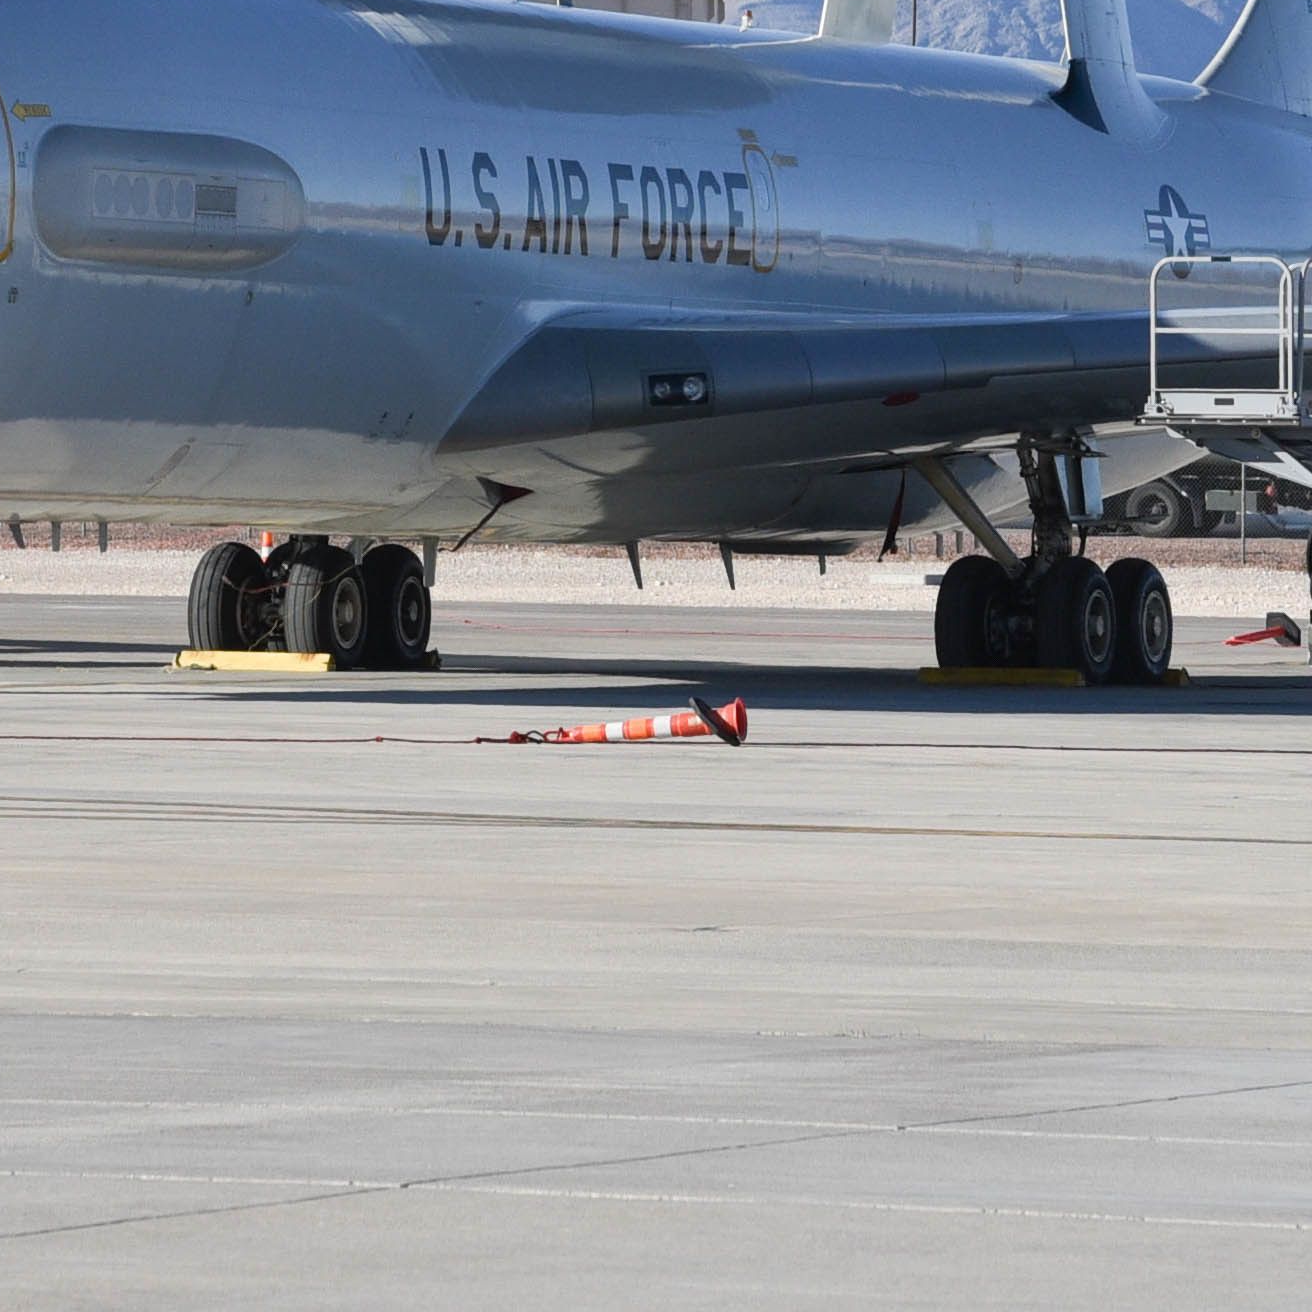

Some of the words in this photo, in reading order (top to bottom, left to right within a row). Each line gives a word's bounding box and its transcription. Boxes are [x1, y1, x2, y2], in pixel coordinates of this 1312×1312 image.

[419, 146, 512, 250] U.S.
[521, 155, 589, 256] AIR
[607, 162, 751, 266] FORCE
